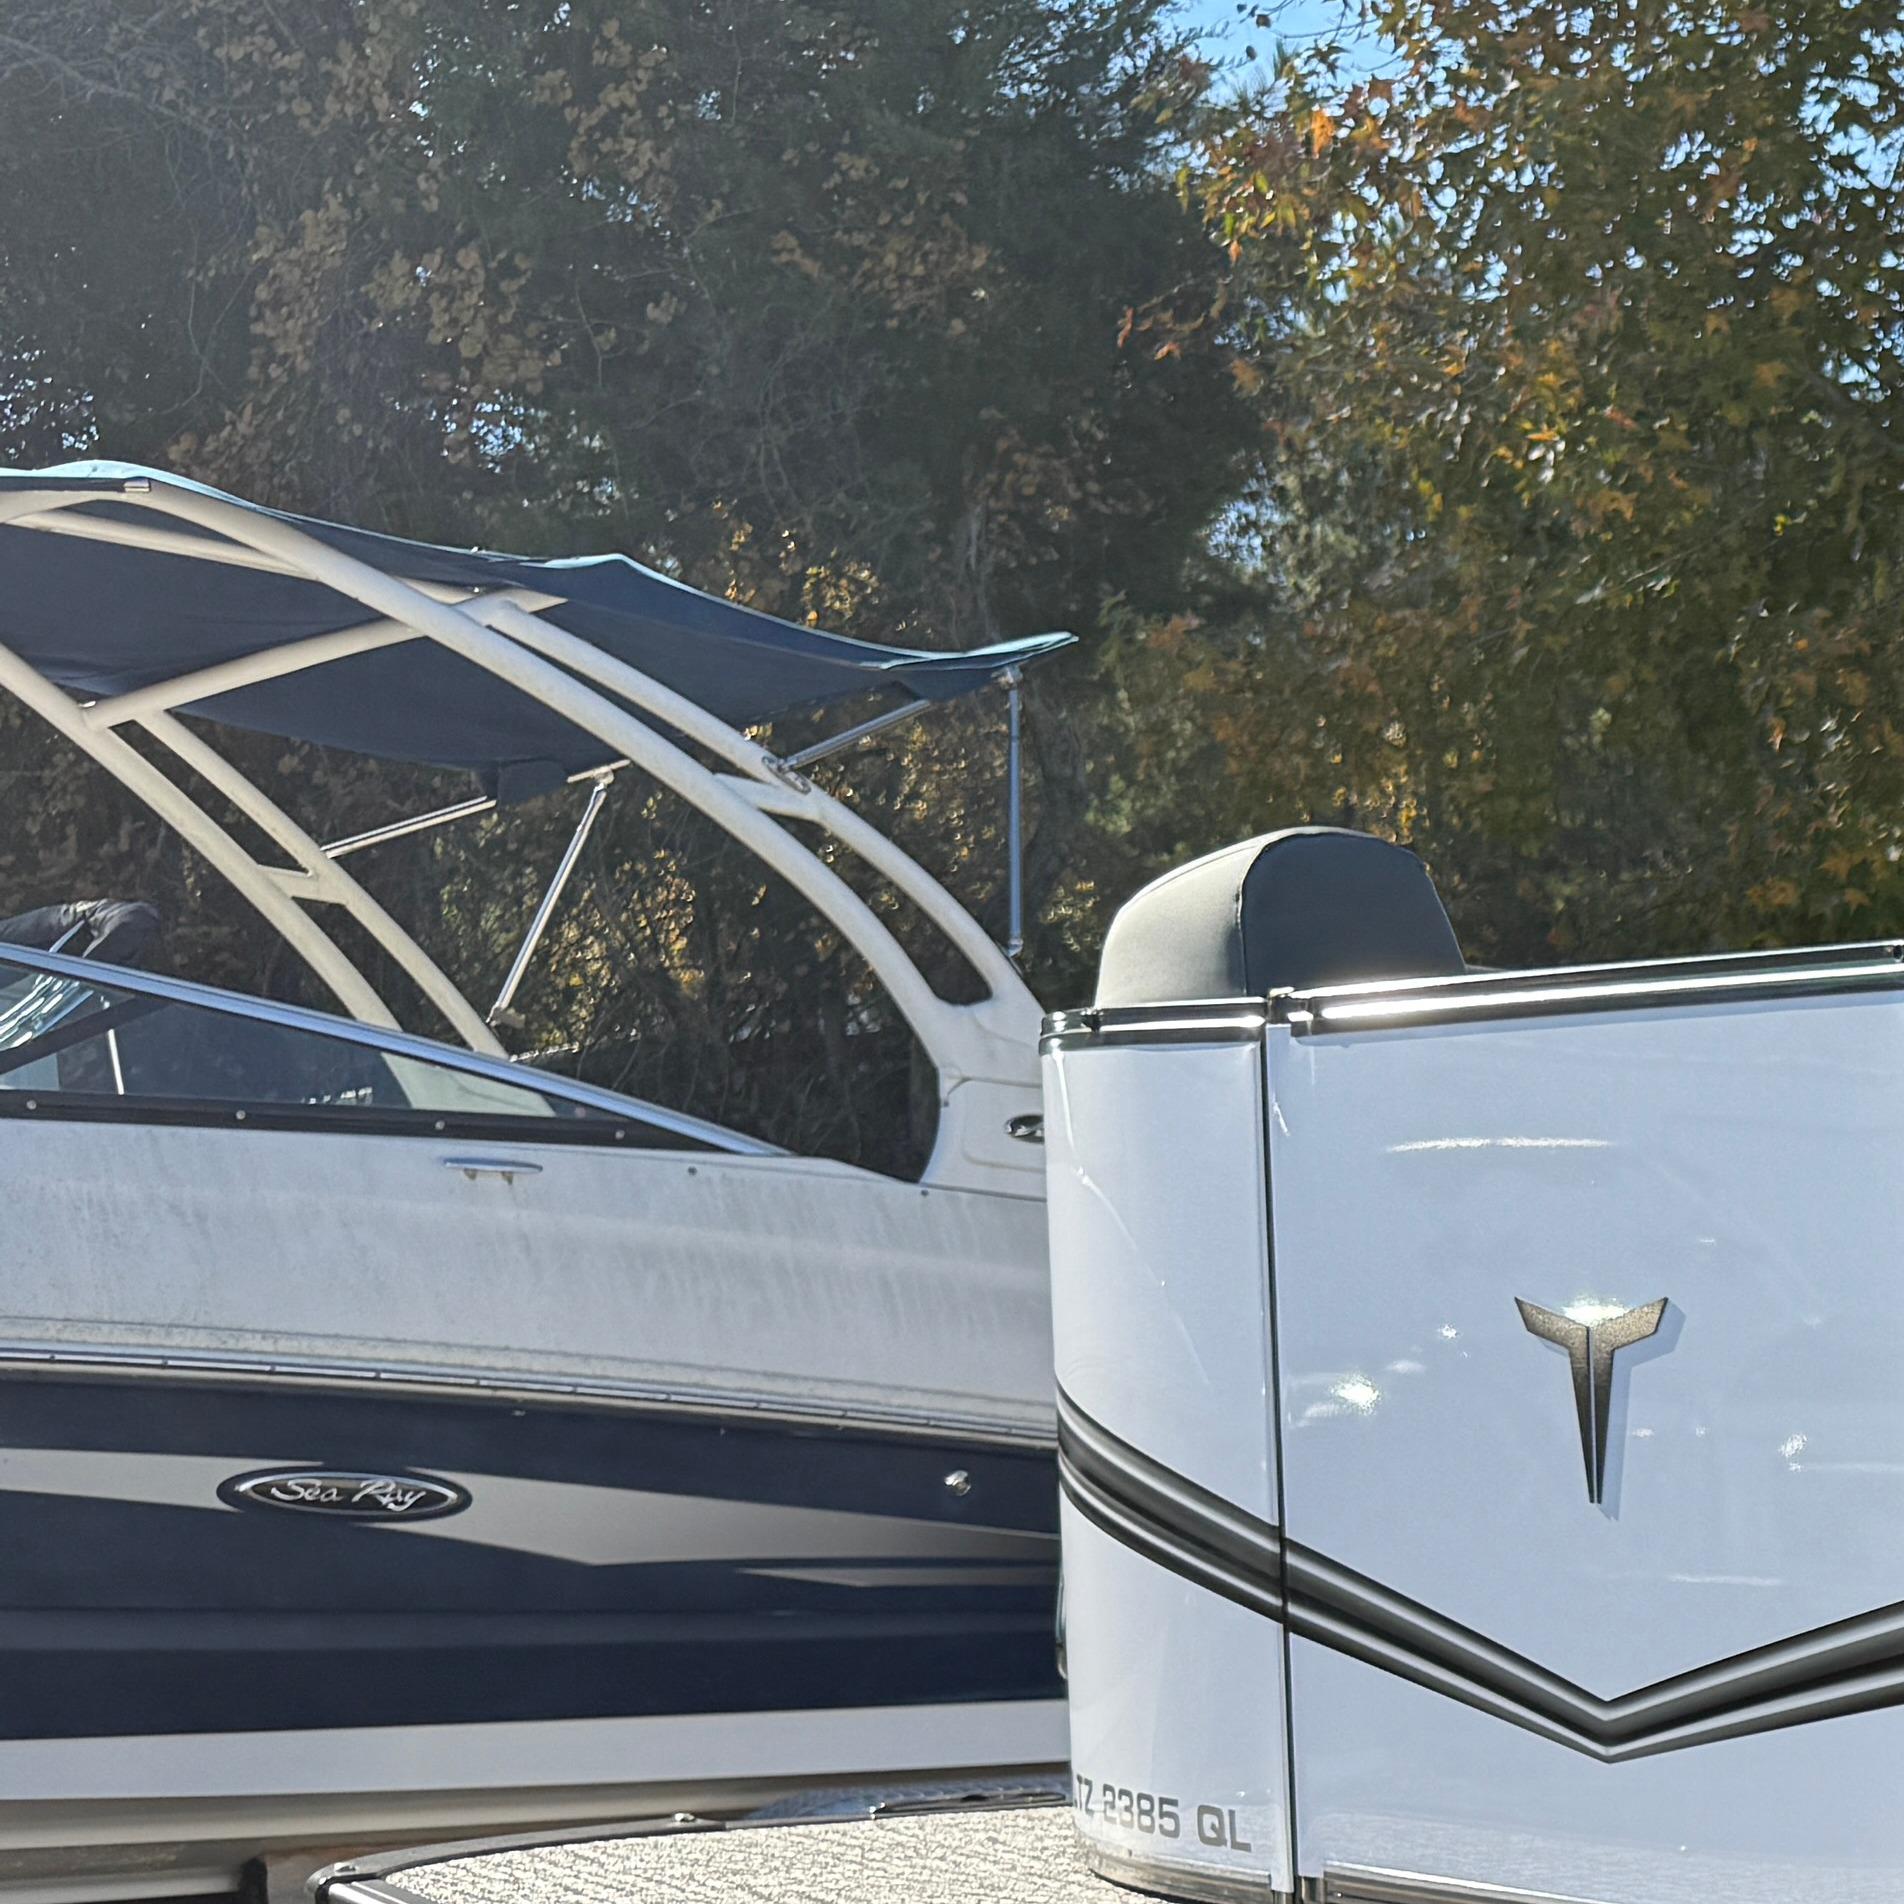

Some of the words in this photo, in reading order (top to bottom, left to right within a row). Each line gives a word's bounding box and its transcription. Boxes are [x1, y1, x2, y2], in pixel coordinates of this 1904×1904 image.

[270, 1478, 343, 1503] Sea
[351, 1479, 425, 1512] Ray
[1102, 1783, 1181, 1839] 2385
[1196, 1804, 1251, 1852] QL
